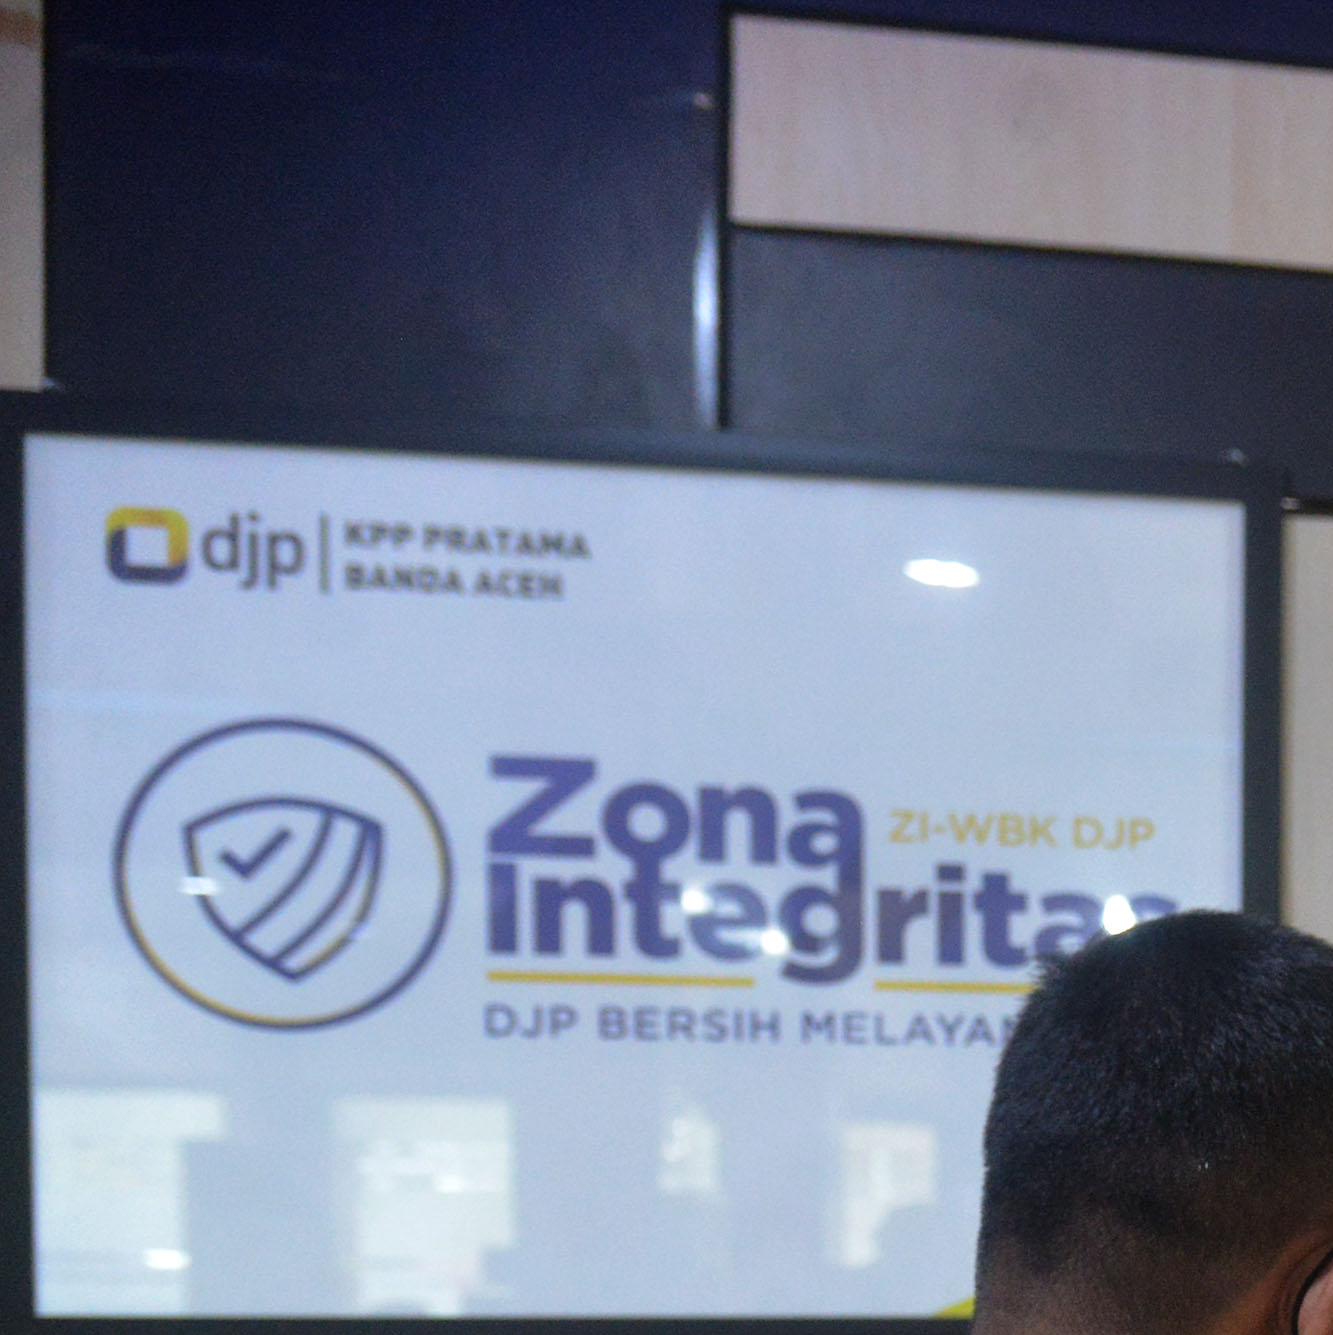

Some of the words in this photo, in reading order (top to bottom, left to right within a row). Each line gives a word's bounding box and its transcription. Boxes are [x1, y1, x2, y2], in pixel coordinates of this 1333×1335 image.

[201, 512, 307, 590] djp
[344, 519, 415, 549] KPP
[423, 523, 594, 560] PRATAMA
[344, 563, 464, 595] BANDA
[473, 569, 566, 601] ACEH
[485, 754, 868, 870] Zona
[888, 808, 1059, 849] ZI-WBK
[1071, 814, 1157, 851] DJP
[485, 858, 1178, 986] Integrita
[484, 1003, 580, 1040] DJP
[597, 1005, 782, 1043] BERSIH
